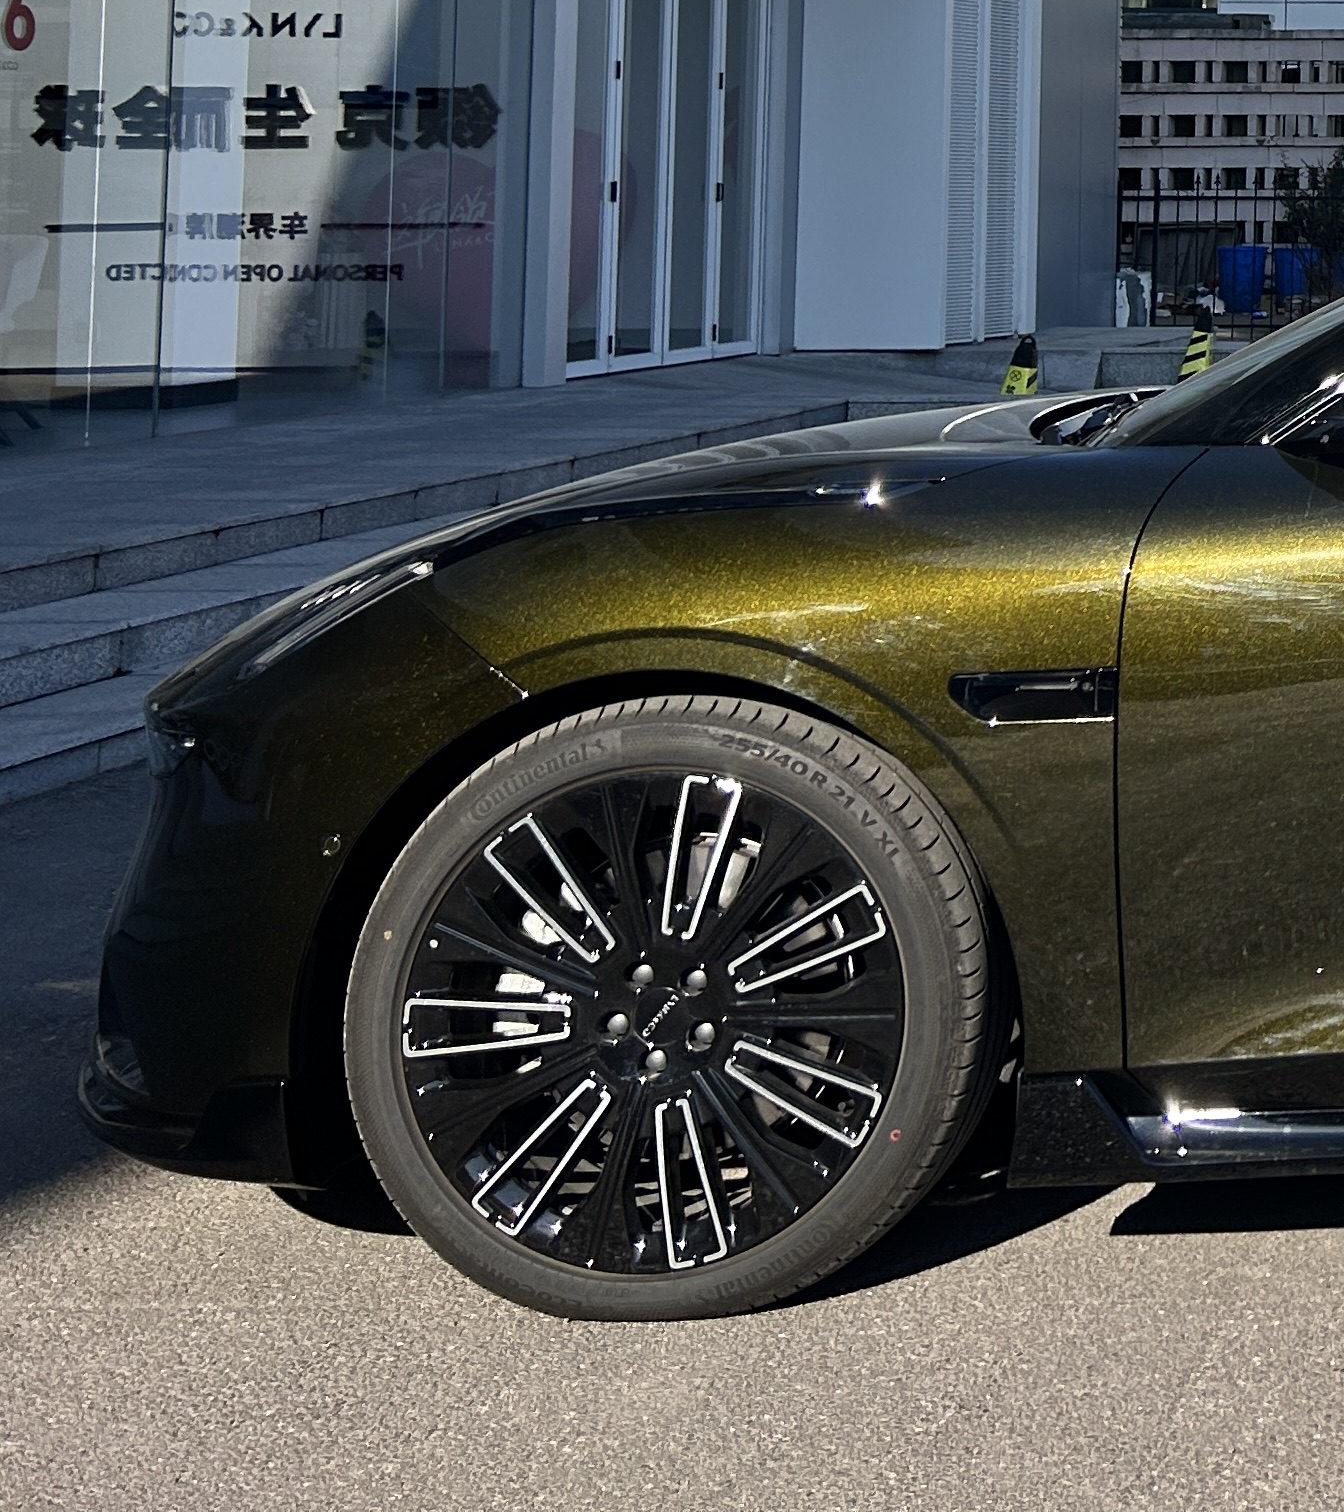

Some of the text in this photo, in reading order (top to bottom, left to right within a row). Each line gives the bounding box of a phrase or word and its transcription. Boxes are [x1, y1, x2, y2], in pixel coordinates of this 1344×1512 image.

[716, 732, 809, 776] 255/40
[809, 769, 829, 790] R
[827, 784, 857, 810] 21
